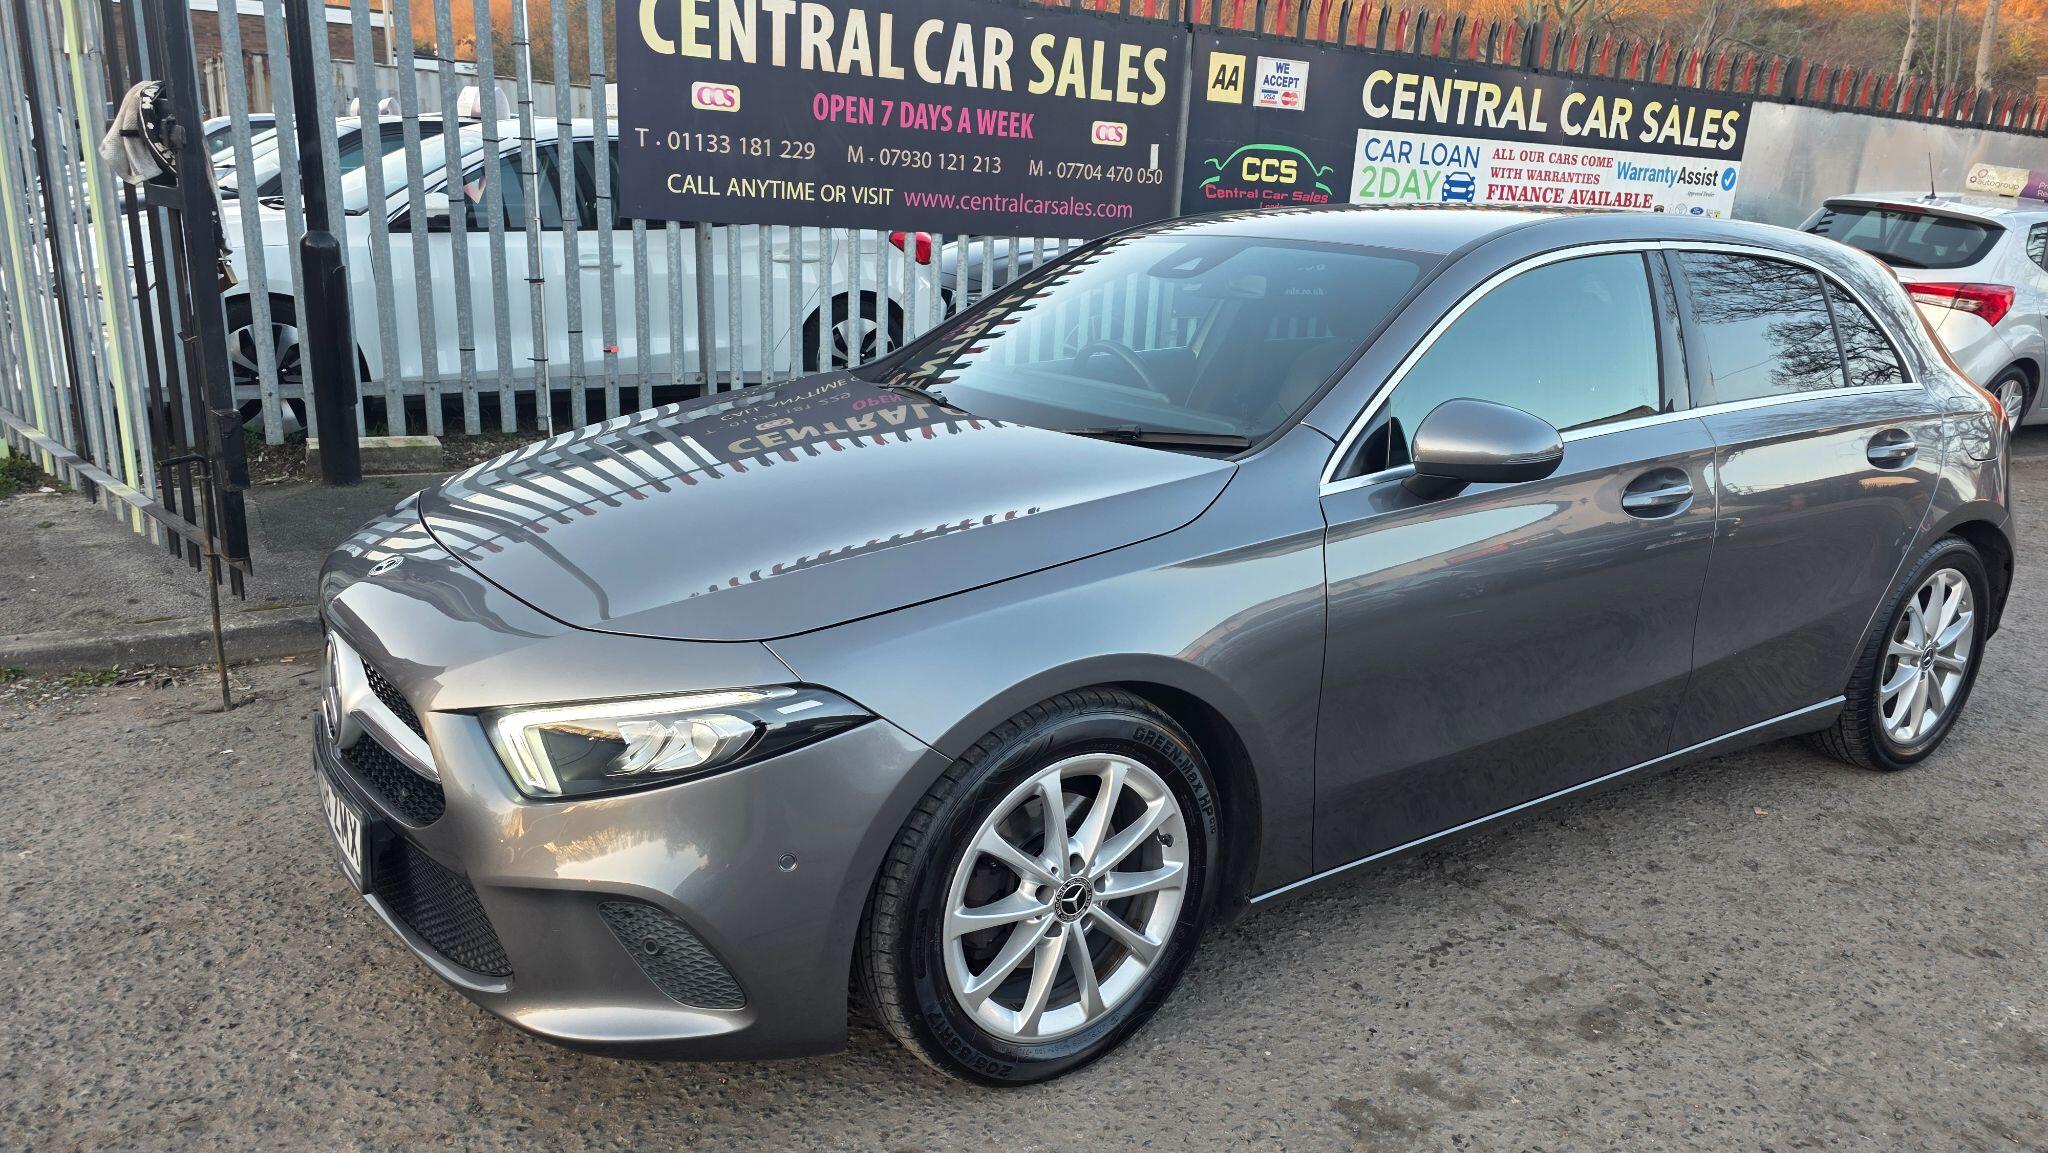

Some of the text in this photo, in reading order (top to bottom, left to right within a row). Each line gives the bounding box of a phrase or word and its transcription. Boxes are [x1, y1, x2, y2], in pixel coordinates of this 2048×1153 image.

[639, 0, 1167, 106] CENTRAL CAR SALES
[1212, 64, 1240, 92] AA
[1263, 74, 1300, 89] ACCEPT
[1276, 61, 1291, 75] WE
[813, 93, 1034, 139] OPEN 7 DAYS A WEEK
[1362, 69, 1741, 150] CENTRAL CAR SALES
[667, 130, 730, 154] 01133
[739, 137, 771, 157] 181
[780, 140, 815, 160] 229
[1365, 137, 1481, 168] CAR LOAN
[1492, 148, 1614, 168] ALL OUR CARS COME
[879, 148, 932, 169] 07930
[938, 153, 966, 171] 121
[973, 156, 1001, 174] 213
[1057, 161, 1102, 181] 07704
[1107, 165, 1133, 183] 470
[1137, 167, 1163, 184] 050
[1242, 156, 1298, 184] CCS
[1359, 165, 1442, 200] 2DAY
[1490, 166, 1601, 185] WITH WARRANTIES
[1977, 179, 2020, 190] autogroup
[667, 173, 1133, 219] CALL ANYTIME OR VISIT www.centralcarsales.com
[1205, 183, 1329, 204] Central Car Sales
[1486, 183, 1654, 208] FINANCE AVAILABLE
